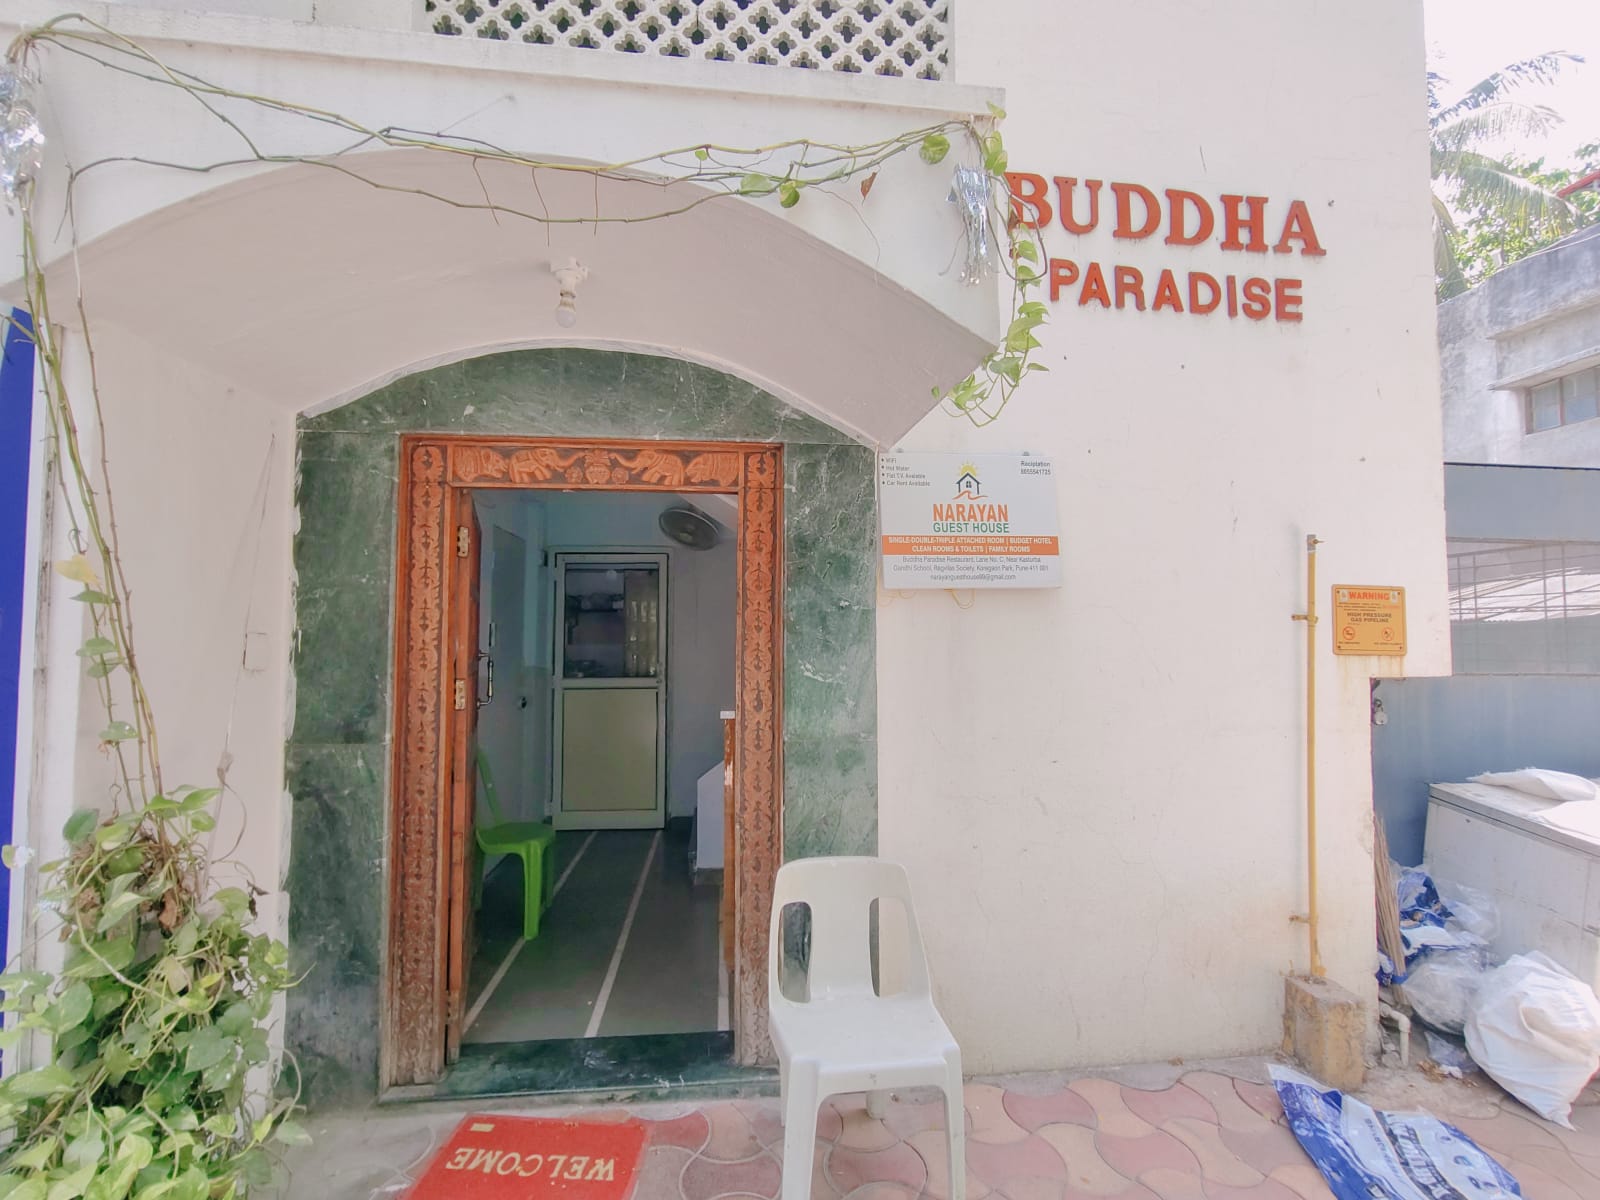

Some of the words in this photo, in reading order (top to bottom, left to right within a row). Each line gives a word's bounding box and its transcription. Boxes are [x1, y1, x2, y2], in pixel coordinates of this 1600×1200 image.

[1003, 171, 1327, 257] BUDDHA
[1049, 258, 1303, 322] PARADISE
[933, 503, 1009, 523] NARAYAN
[933, 522, 969, 533] GUEST
[972, 523, 1010, 534] HOUSE
[956, 536, 986, 544] ATTACHED
[1010, 537, 1032, 545] BUDGET
[1033, 537, 1053, 545] HOTEL
[961, 545, 984, 553] TOILETS
[1348, 591, 1390, 601] WARNING
[446, 1147, 615, 1181] WELCOME
